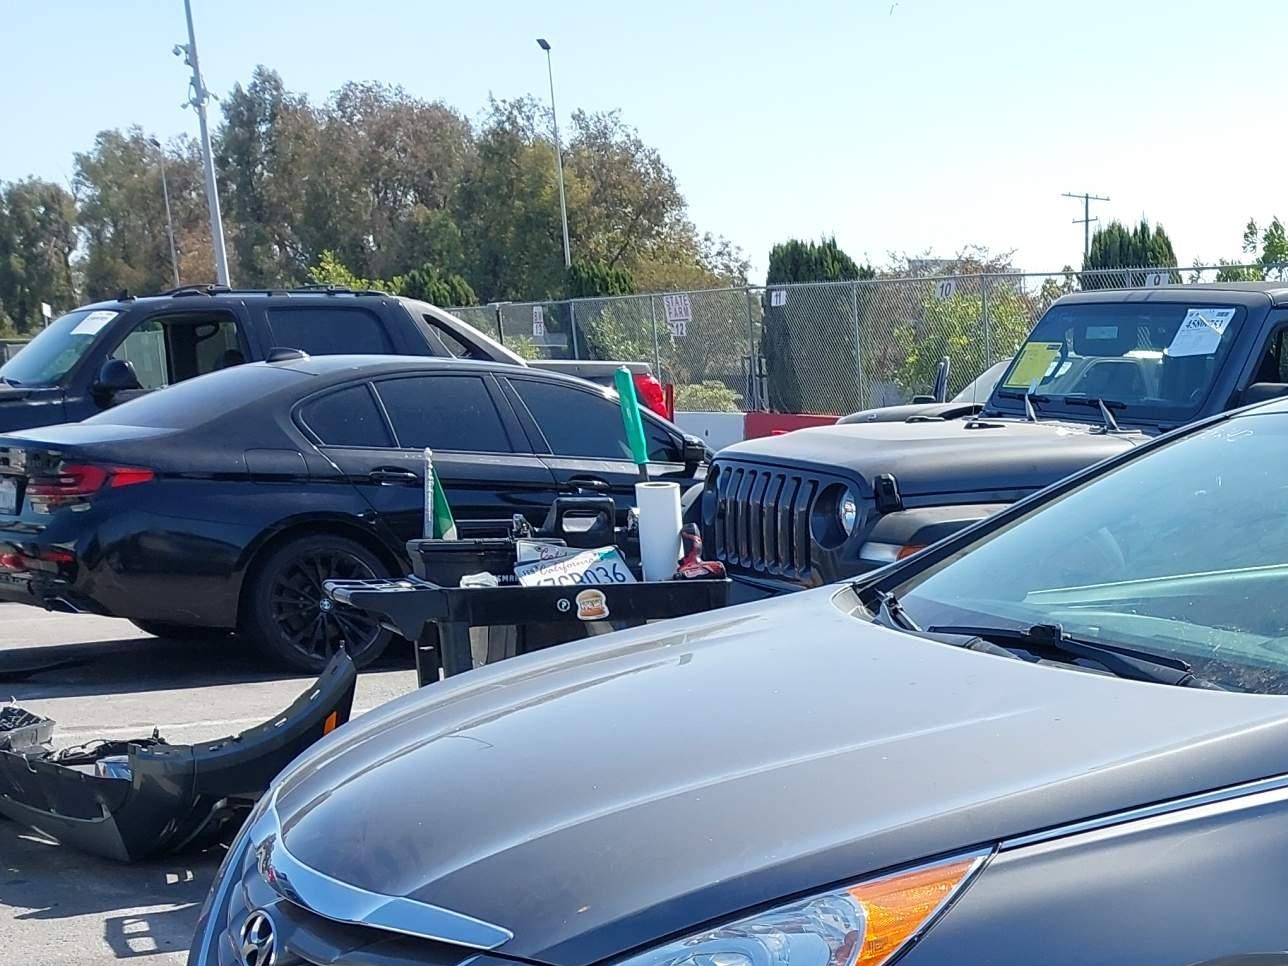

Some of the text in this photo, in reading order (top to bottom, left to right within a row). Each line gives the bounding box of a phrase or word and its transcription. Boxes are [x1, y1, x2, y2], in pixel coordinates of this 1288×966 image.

[939, 283, 952, 297] 10
[665, 295, 689, 306] STATE
[669, 306, 689, 318] FARM
[675, 322, 684, 335] 12
[540, 558, 594, 575] California
